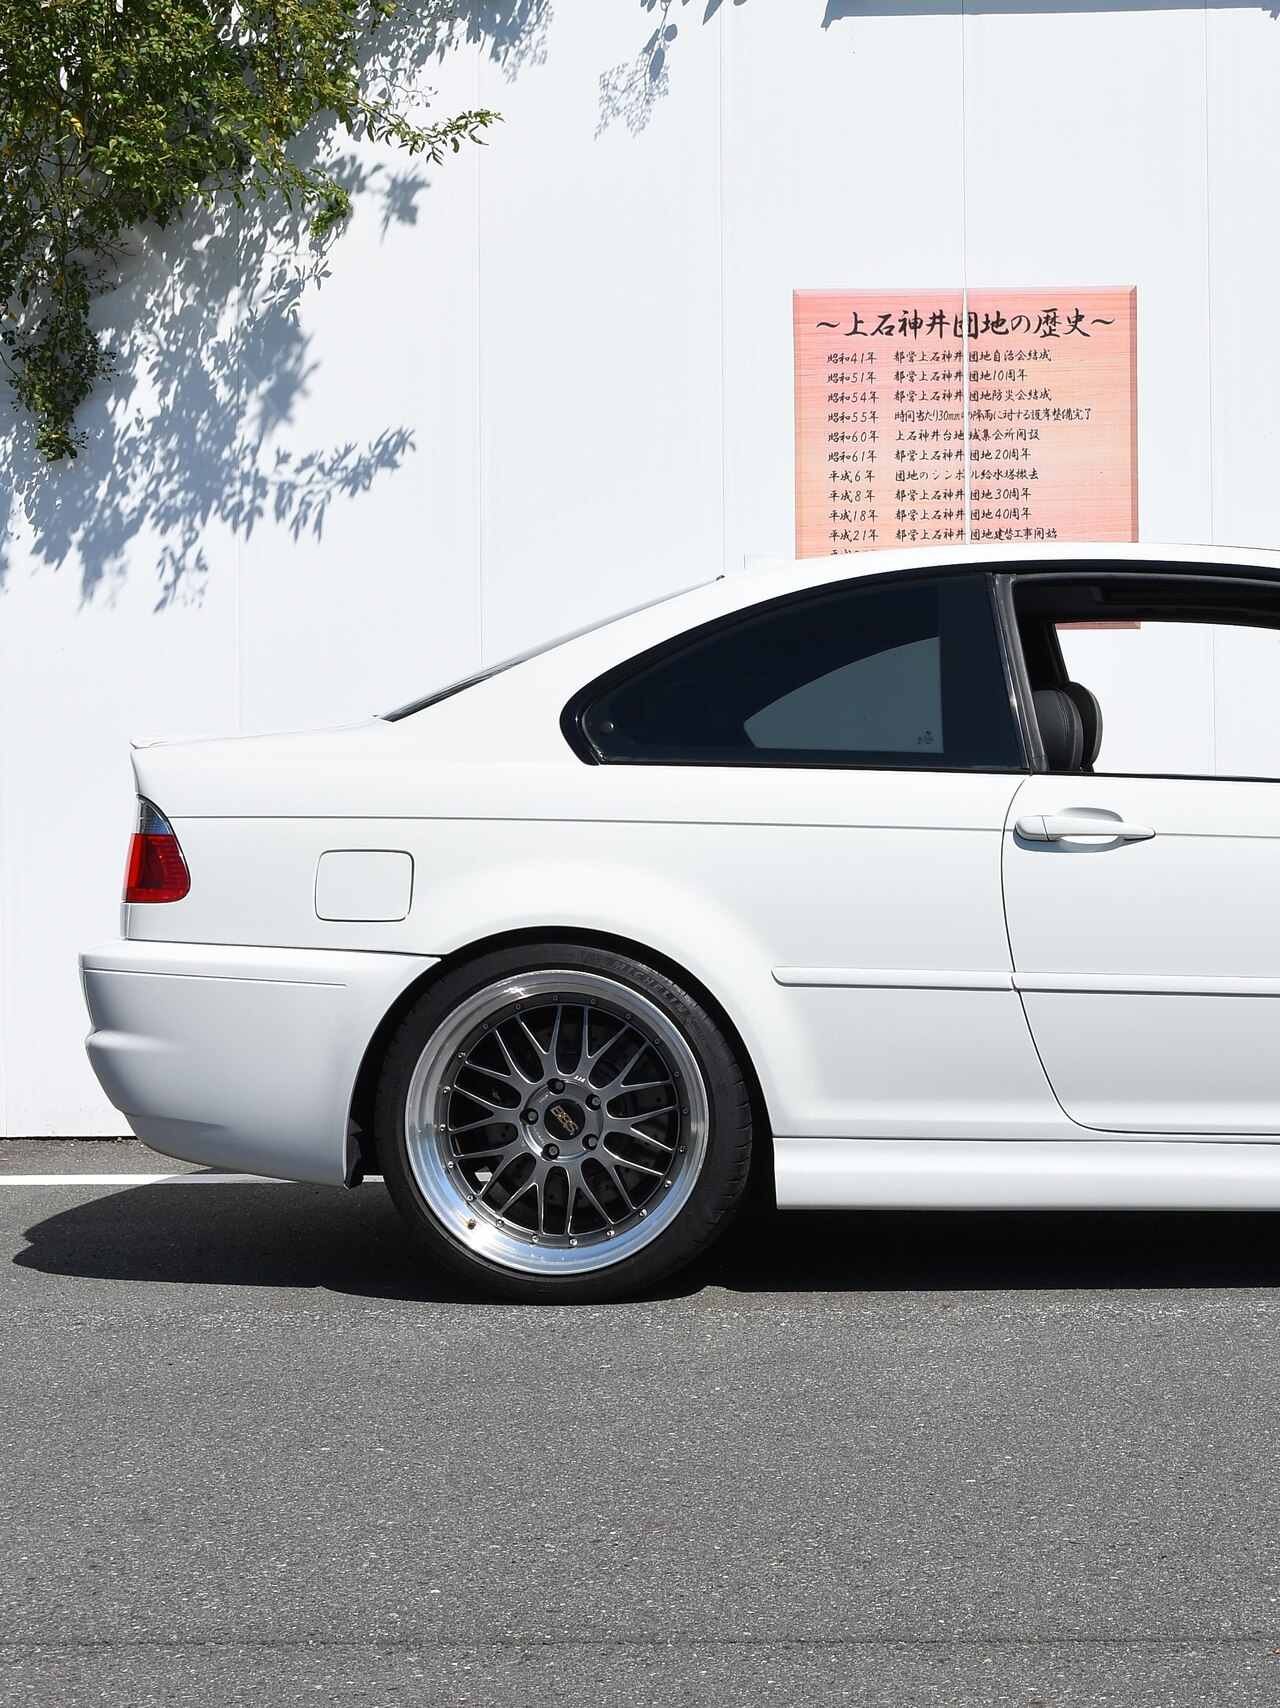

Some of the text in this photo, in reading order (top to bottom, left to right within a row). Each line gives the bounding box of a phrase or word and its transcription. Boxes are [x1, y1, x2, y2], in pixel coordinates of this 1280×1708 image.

[827, 348, 1051, 364] 昭和41年 都営上石神井団地自治会結成
[827, 369, 1027, 384] 昭和51年 都営上石神井団地10周年
[827, 388, 1051, 403] 昭和54年 都営上石神井団地防災会結成
[828, 411, 879, 423] 昭和55年
[828, 430, 879, 443] 昭和60年
[828, 448, 1031, 463] 昭和61年 都営上石神井団地20周年
[895, 488, 1031, 501] 都営上石神井団地30周年
[829, 507, 1031, 522] 平成18年 都営上石神井団地40周年
[829, 529, 878, 541] 平成21年
[611, 961, 691, 1018] MICHELIN
[550, 1104, 579, 1134] BBS
